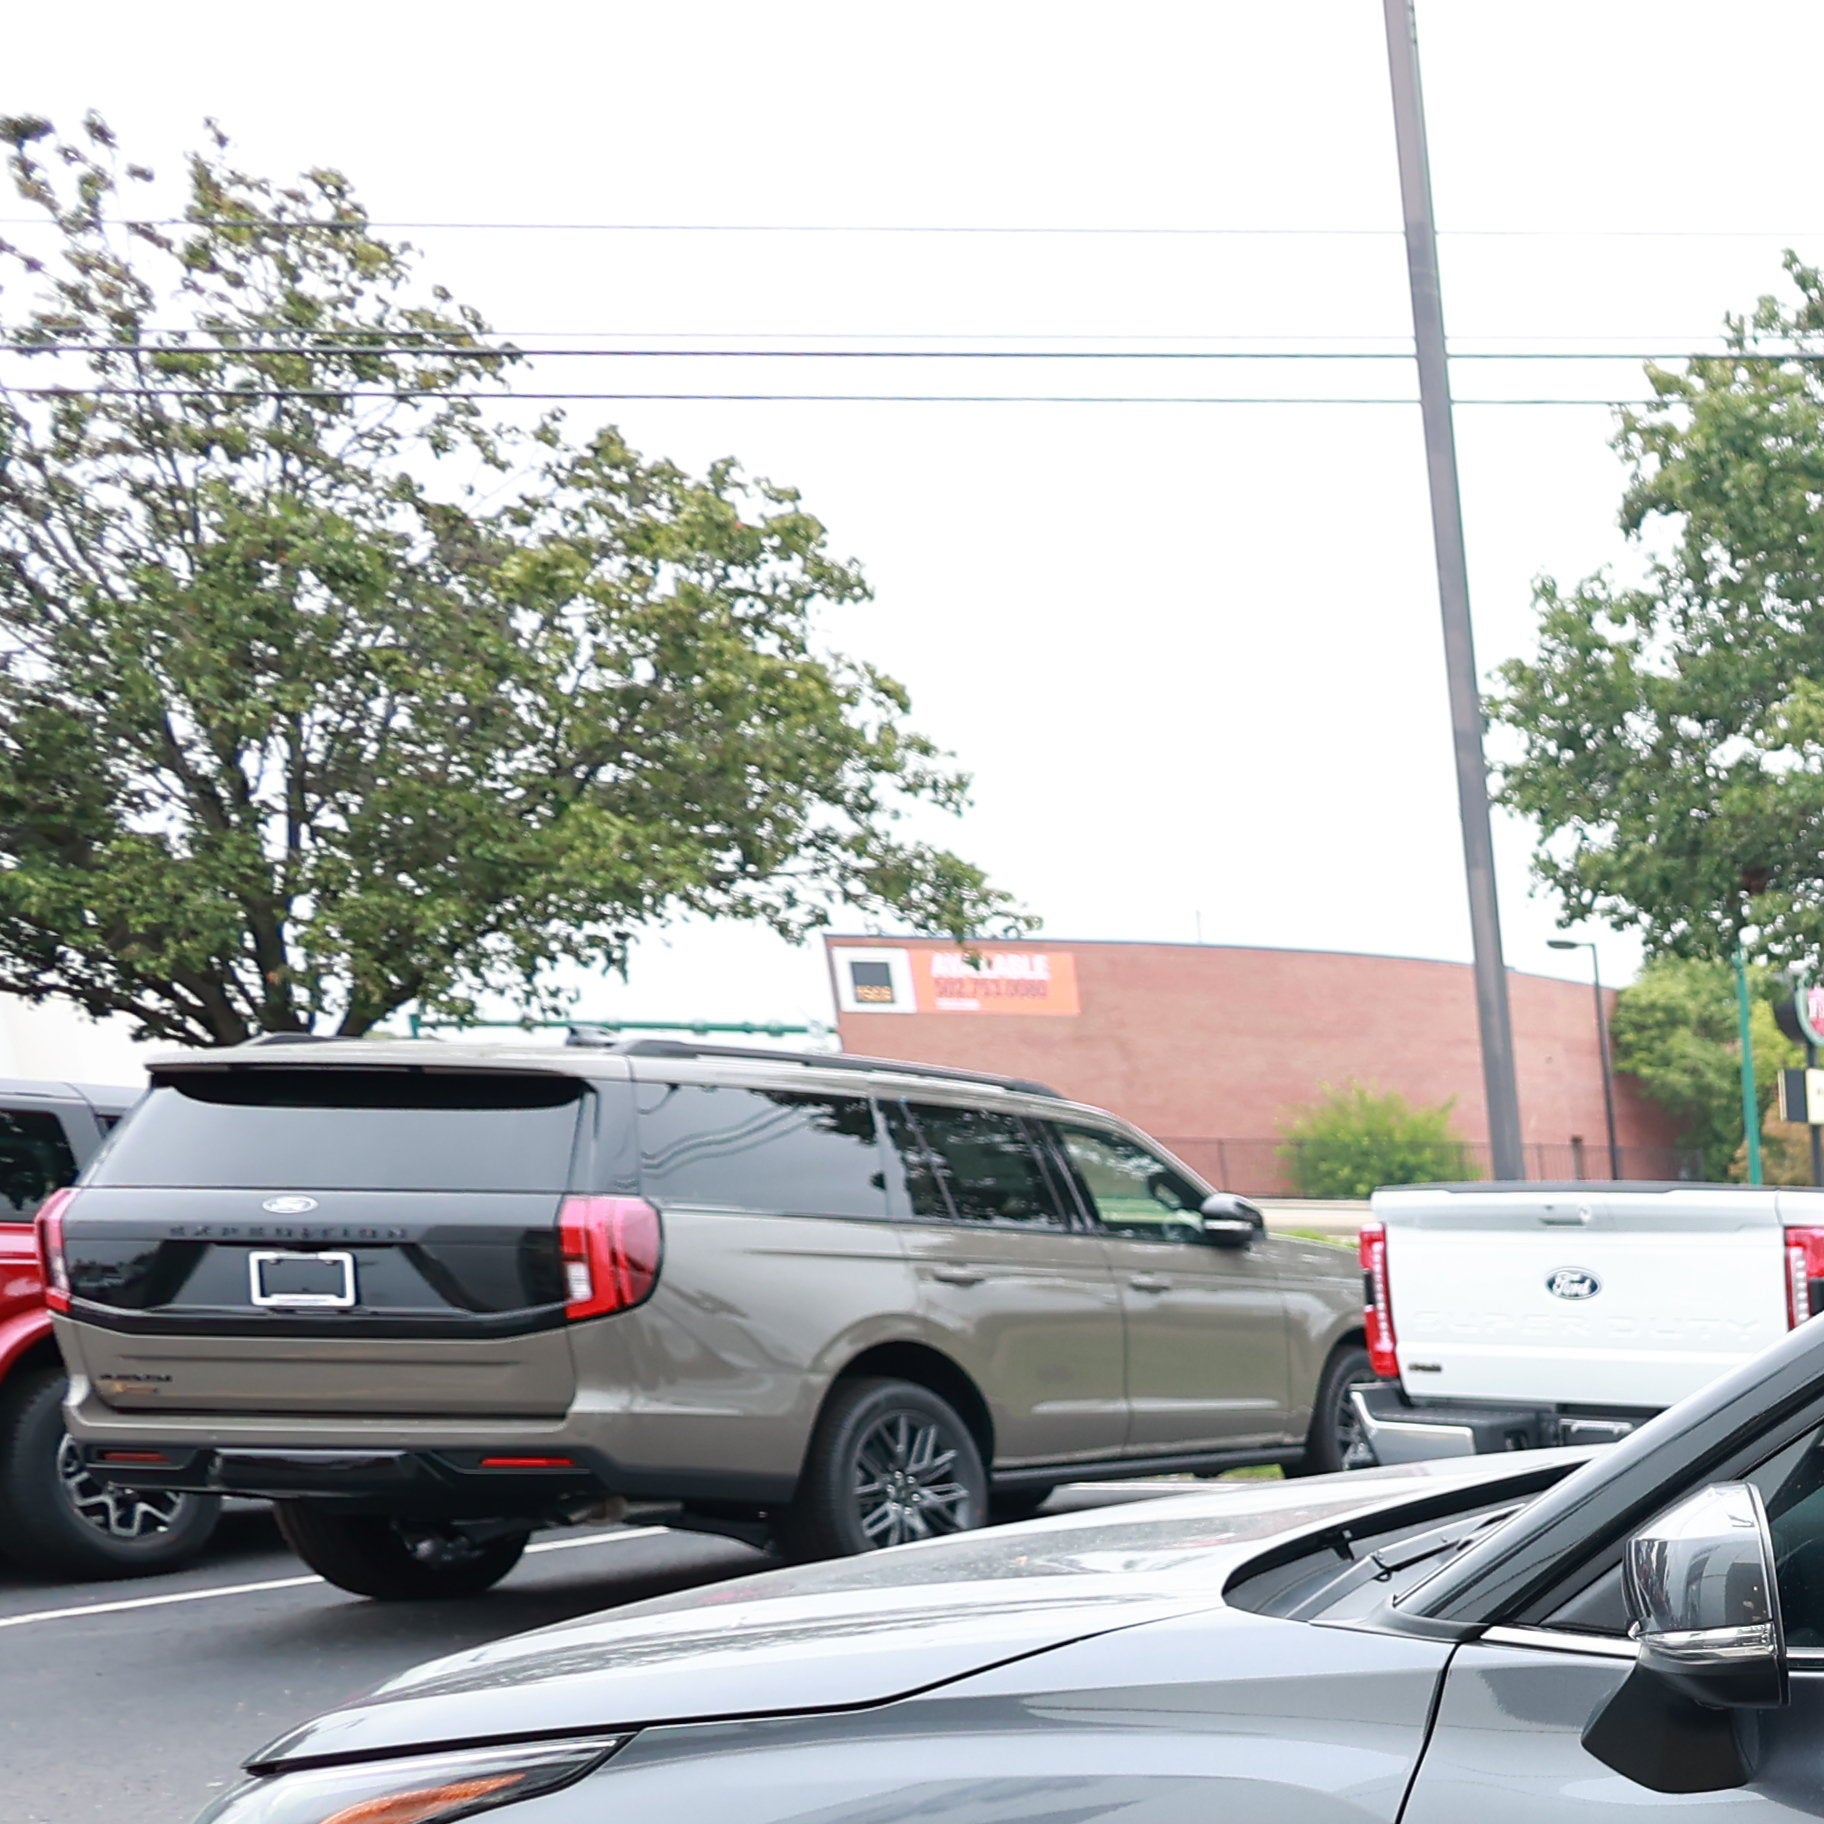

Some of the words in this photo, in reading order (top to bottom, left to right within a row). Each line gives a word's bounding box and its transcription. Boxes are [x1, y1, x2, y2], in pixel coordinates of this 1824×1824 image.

[1553, 1270, 1591, 1297] Ford
[1412, 1309, 1592, 1337] SUPER
[1606, 1315, 1762, 1342] DUTY
